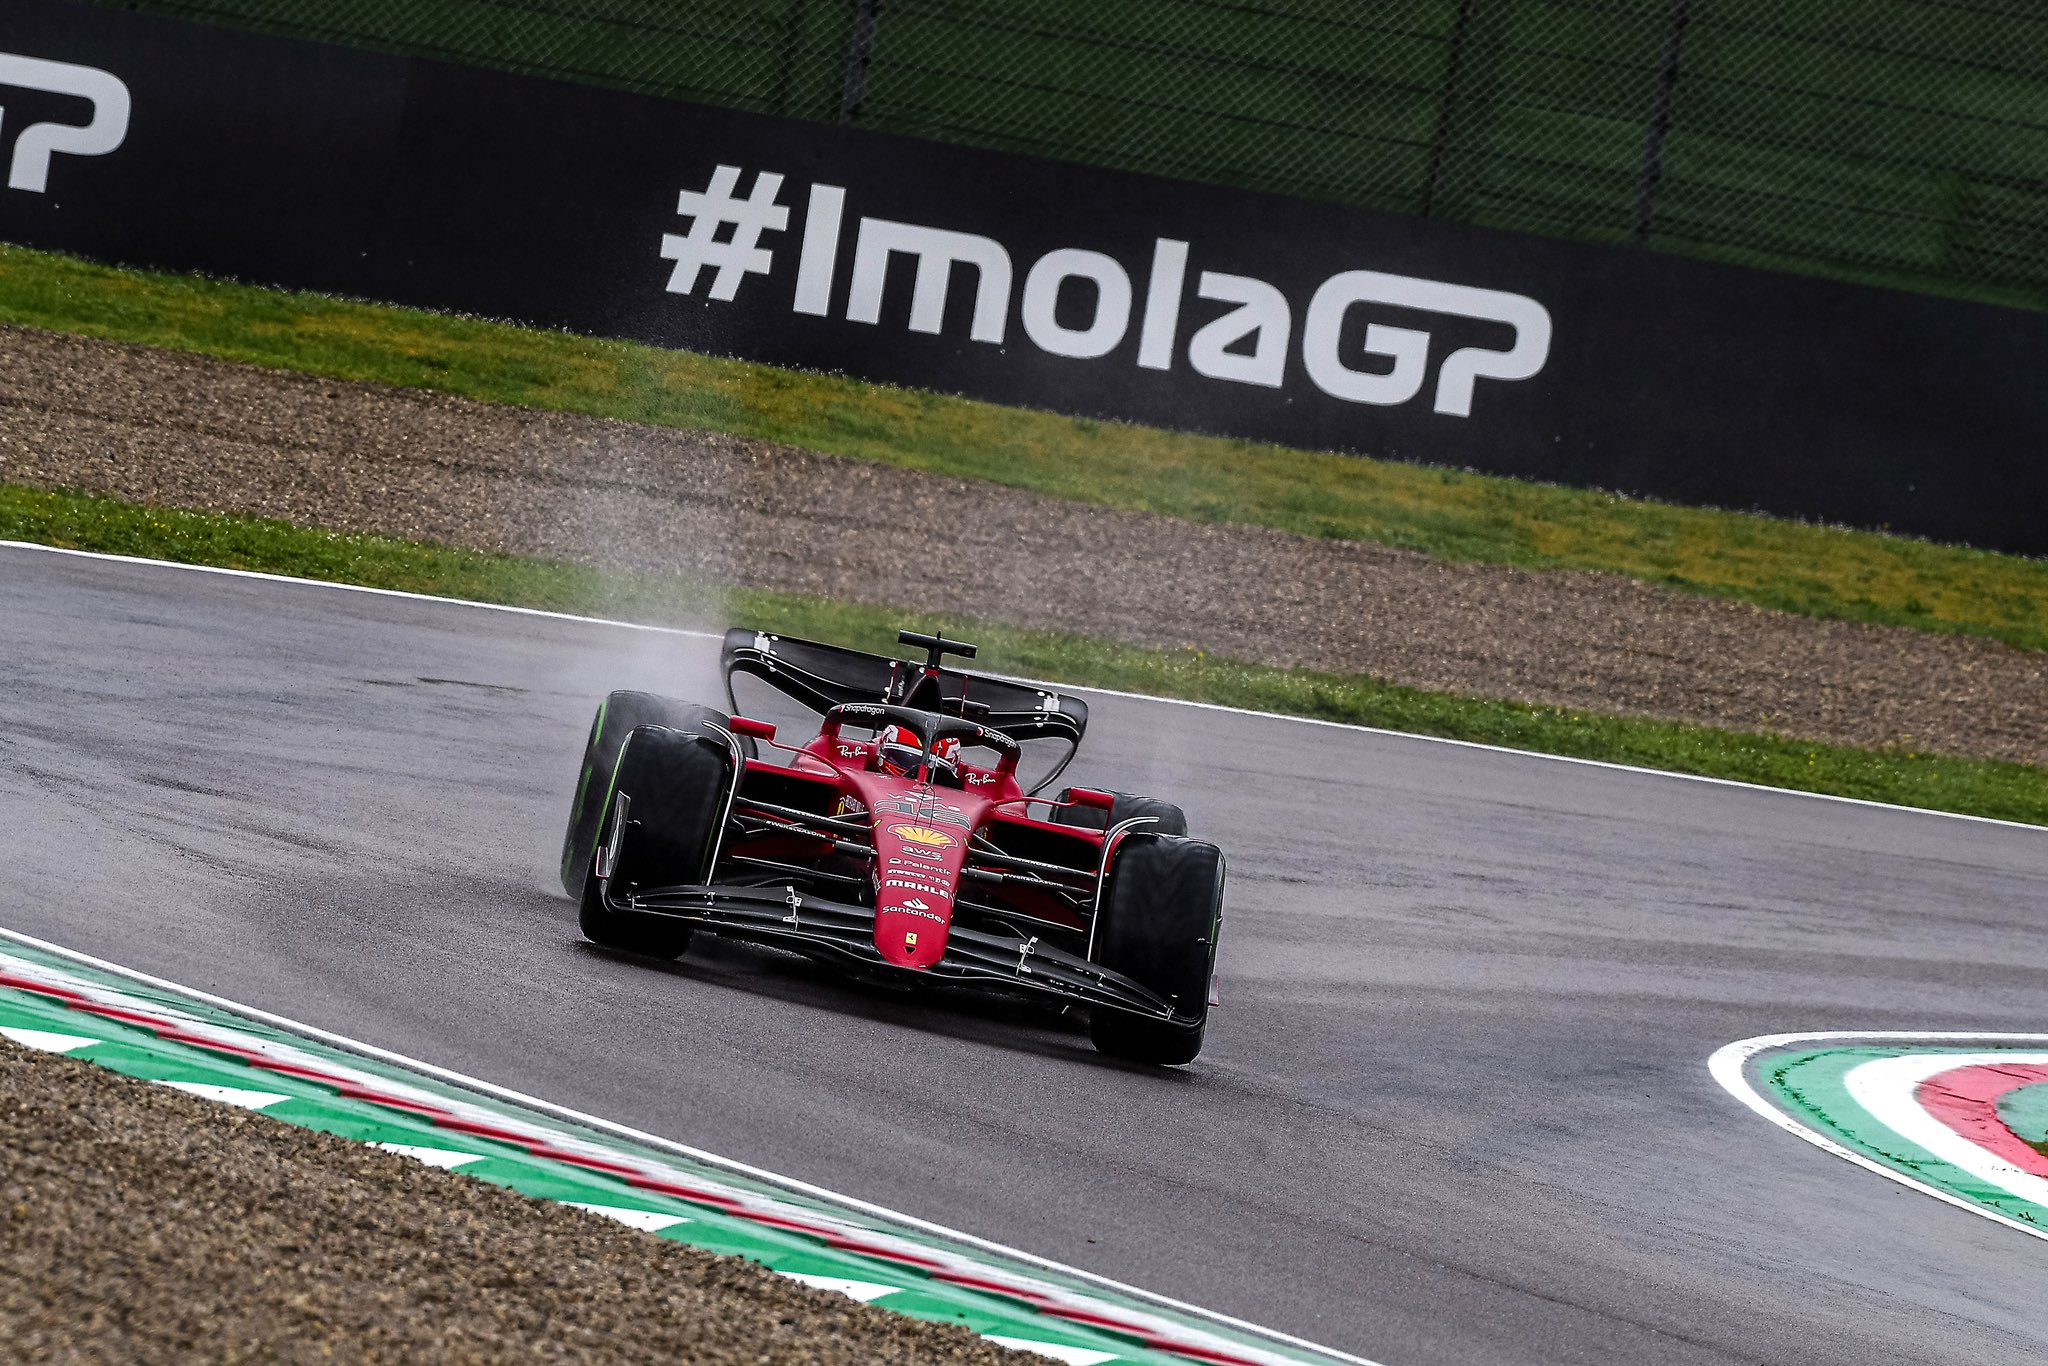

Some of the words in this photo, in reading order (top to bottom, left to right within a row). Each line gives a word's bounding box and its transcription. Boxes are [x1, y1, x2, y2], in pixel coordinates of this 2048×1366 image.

[0, 52, 132, 194] P
[660, 163, 1553, 418] #ImolaGP
[844, 703, 886, 716] Snapdragon
[984, 728, 1017, 749] Snapdragon
[837, 744, 868, 758] Ray-Ban
[965, 773, 996, 786] Ray-Ban
[902, 845, 942, 860] aws
[903, 860, 952, 876] Palantir
[885, 879, 950, 900] MAHLE
[882, 905, 946, 925] Santander
